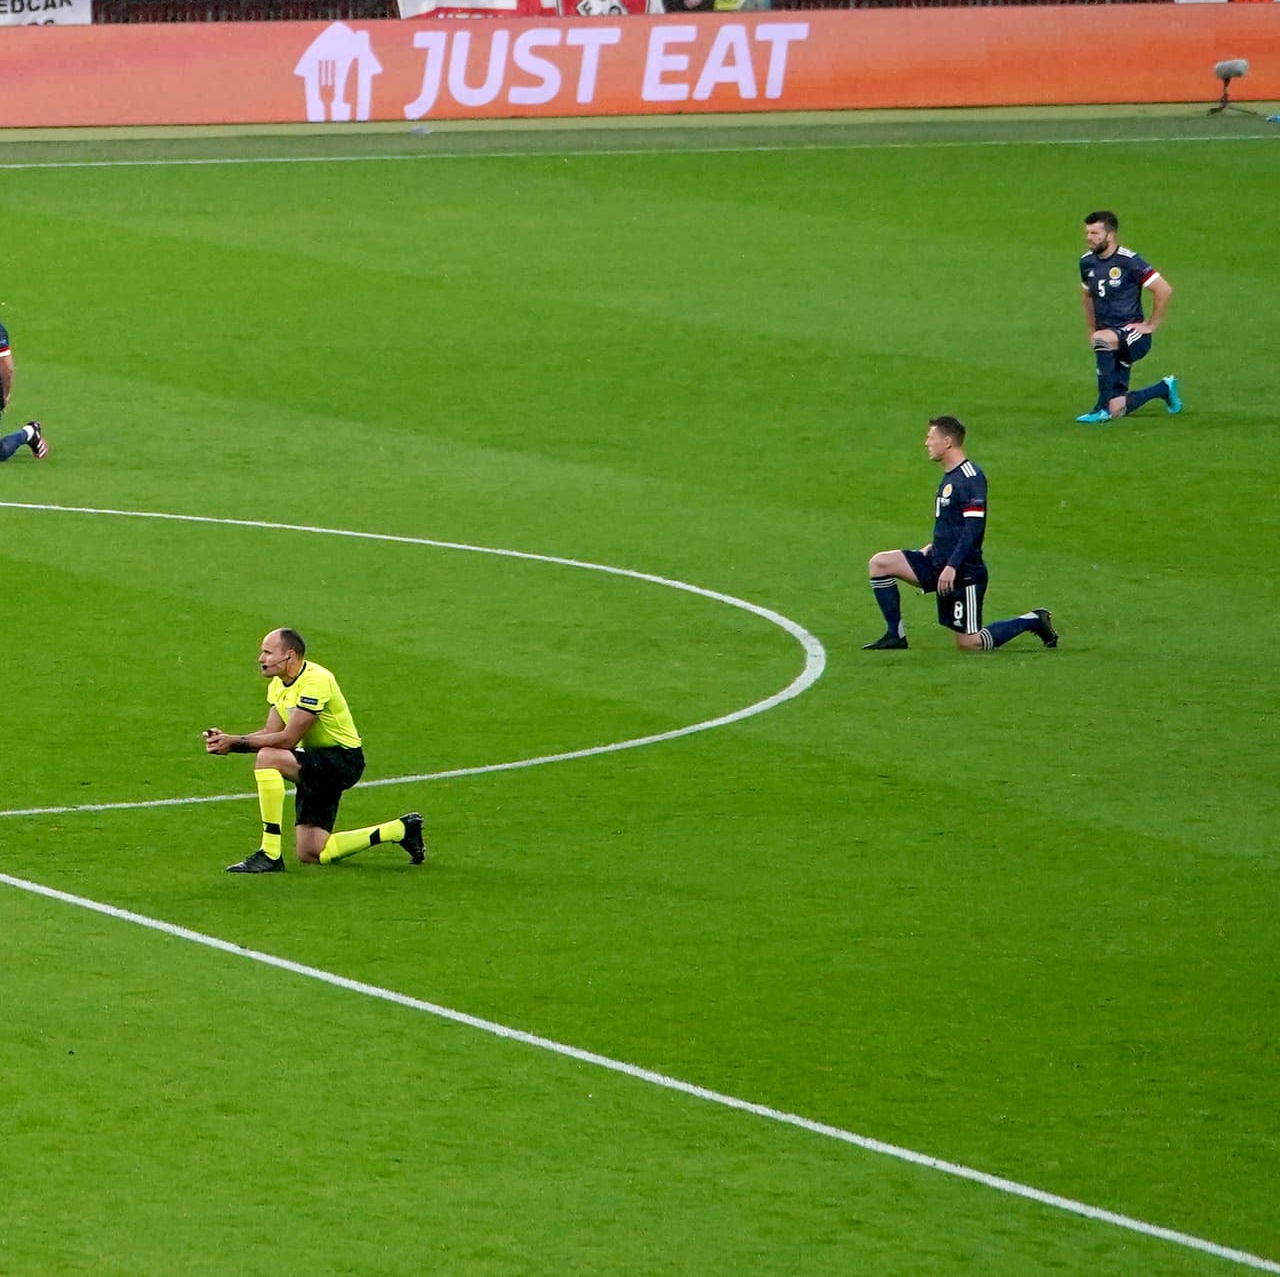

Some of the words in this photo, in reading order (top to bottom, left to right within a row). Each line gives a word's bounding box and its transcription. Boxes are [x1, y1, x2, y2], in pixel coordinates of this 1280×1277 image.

[402, 26, 622, 120] JUST
[641, 22, 810, 102] EAT
[1098, 278, 1106, 298] 5
[953, 600, 964, 620] 8
